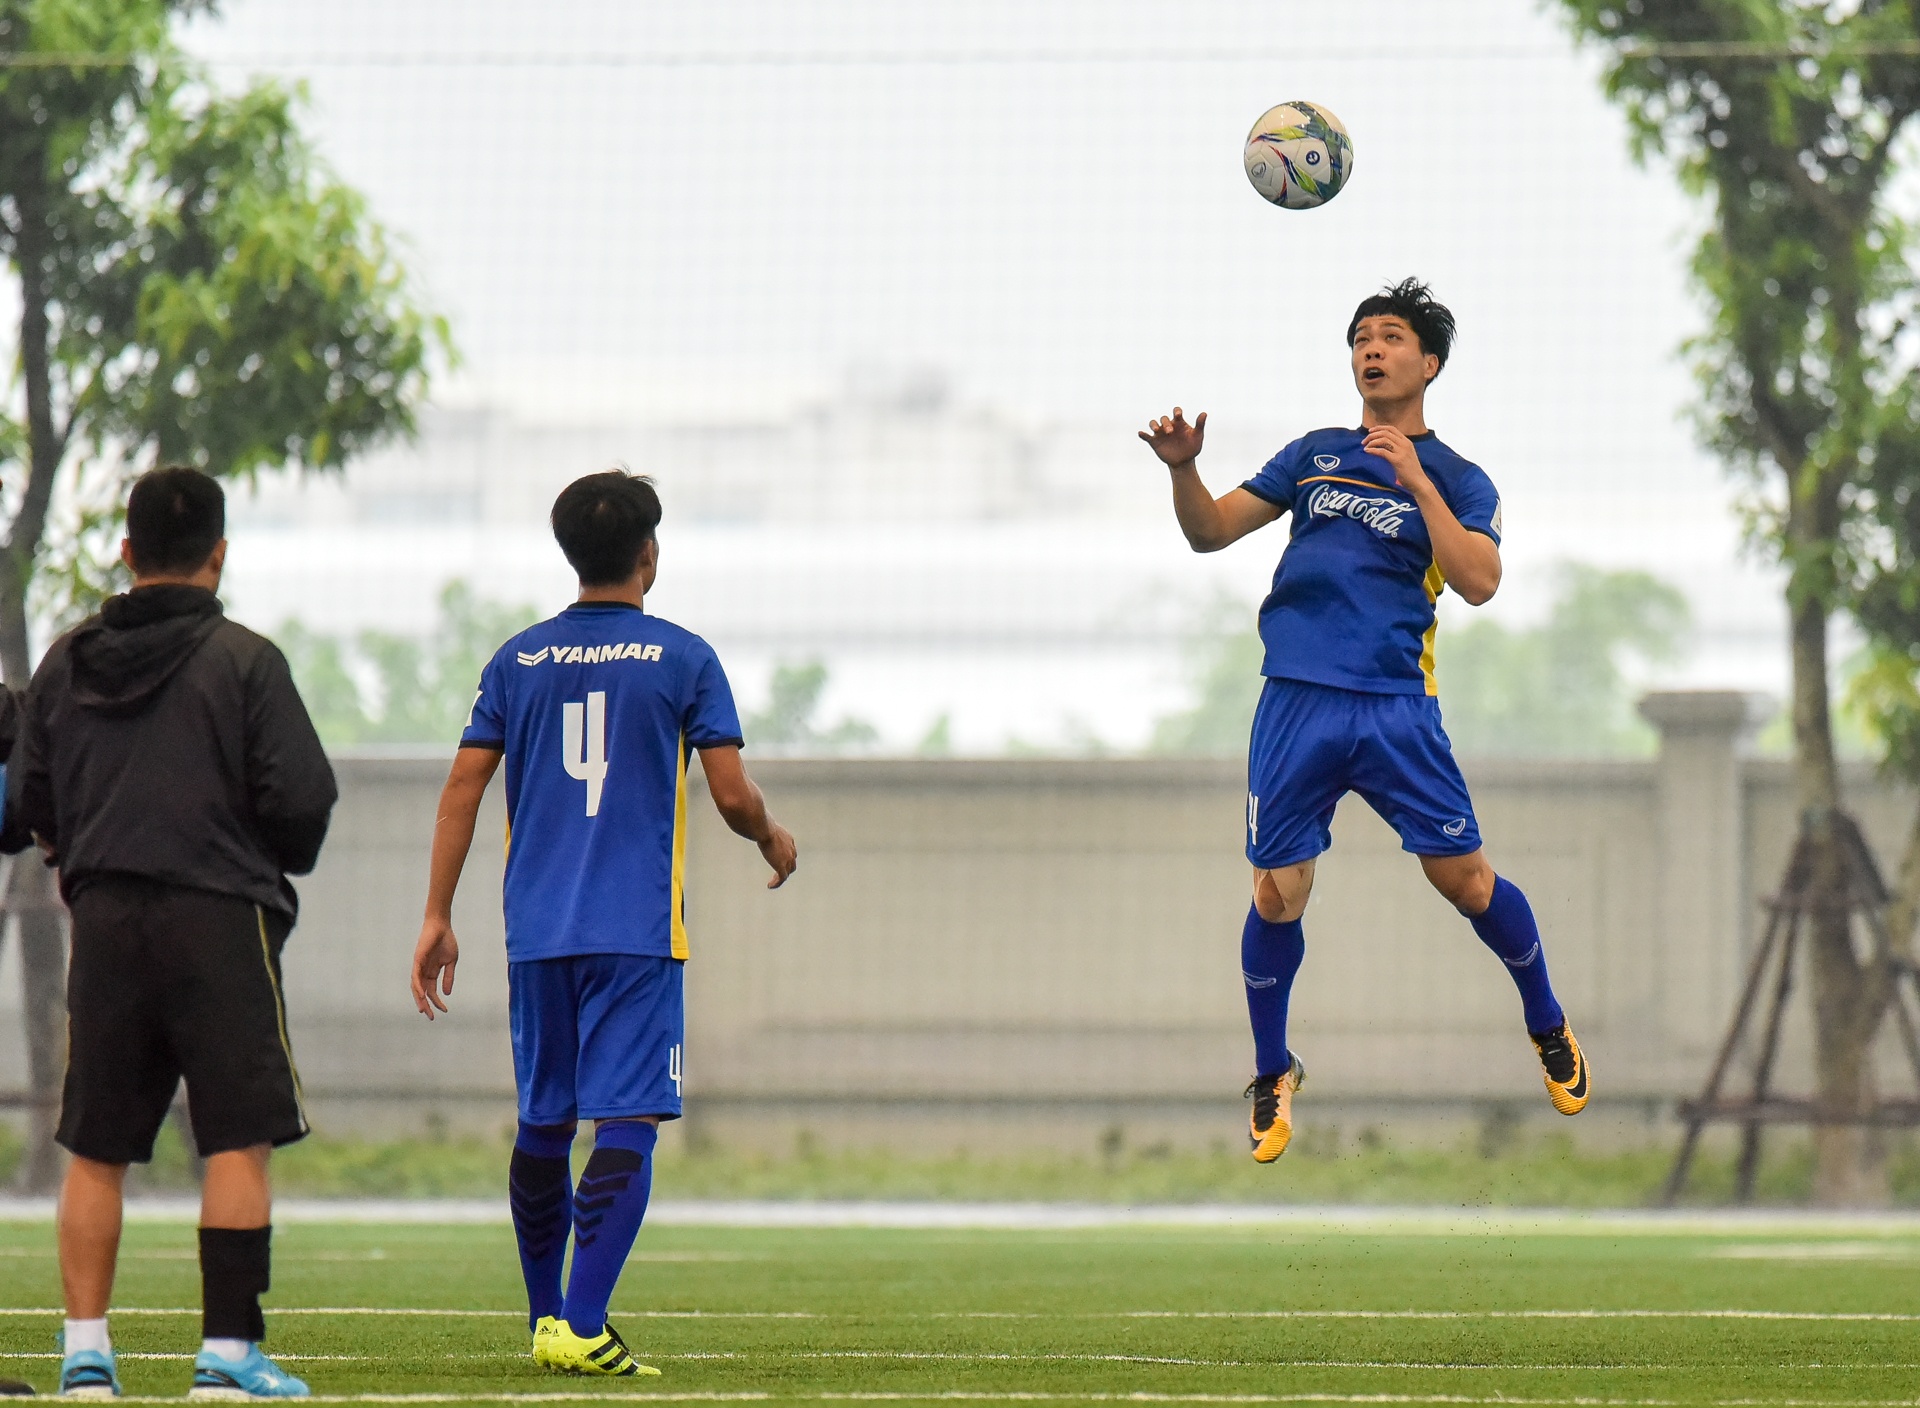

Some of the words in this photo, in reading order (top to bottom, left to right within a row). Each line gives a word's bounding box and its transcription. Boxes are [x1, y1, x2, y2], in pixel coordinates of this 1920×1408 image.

[551, 643, 663, 664] YANMAR
[562, 691, 608, 817] 4
[669, 1043, 682, 1097] 4
